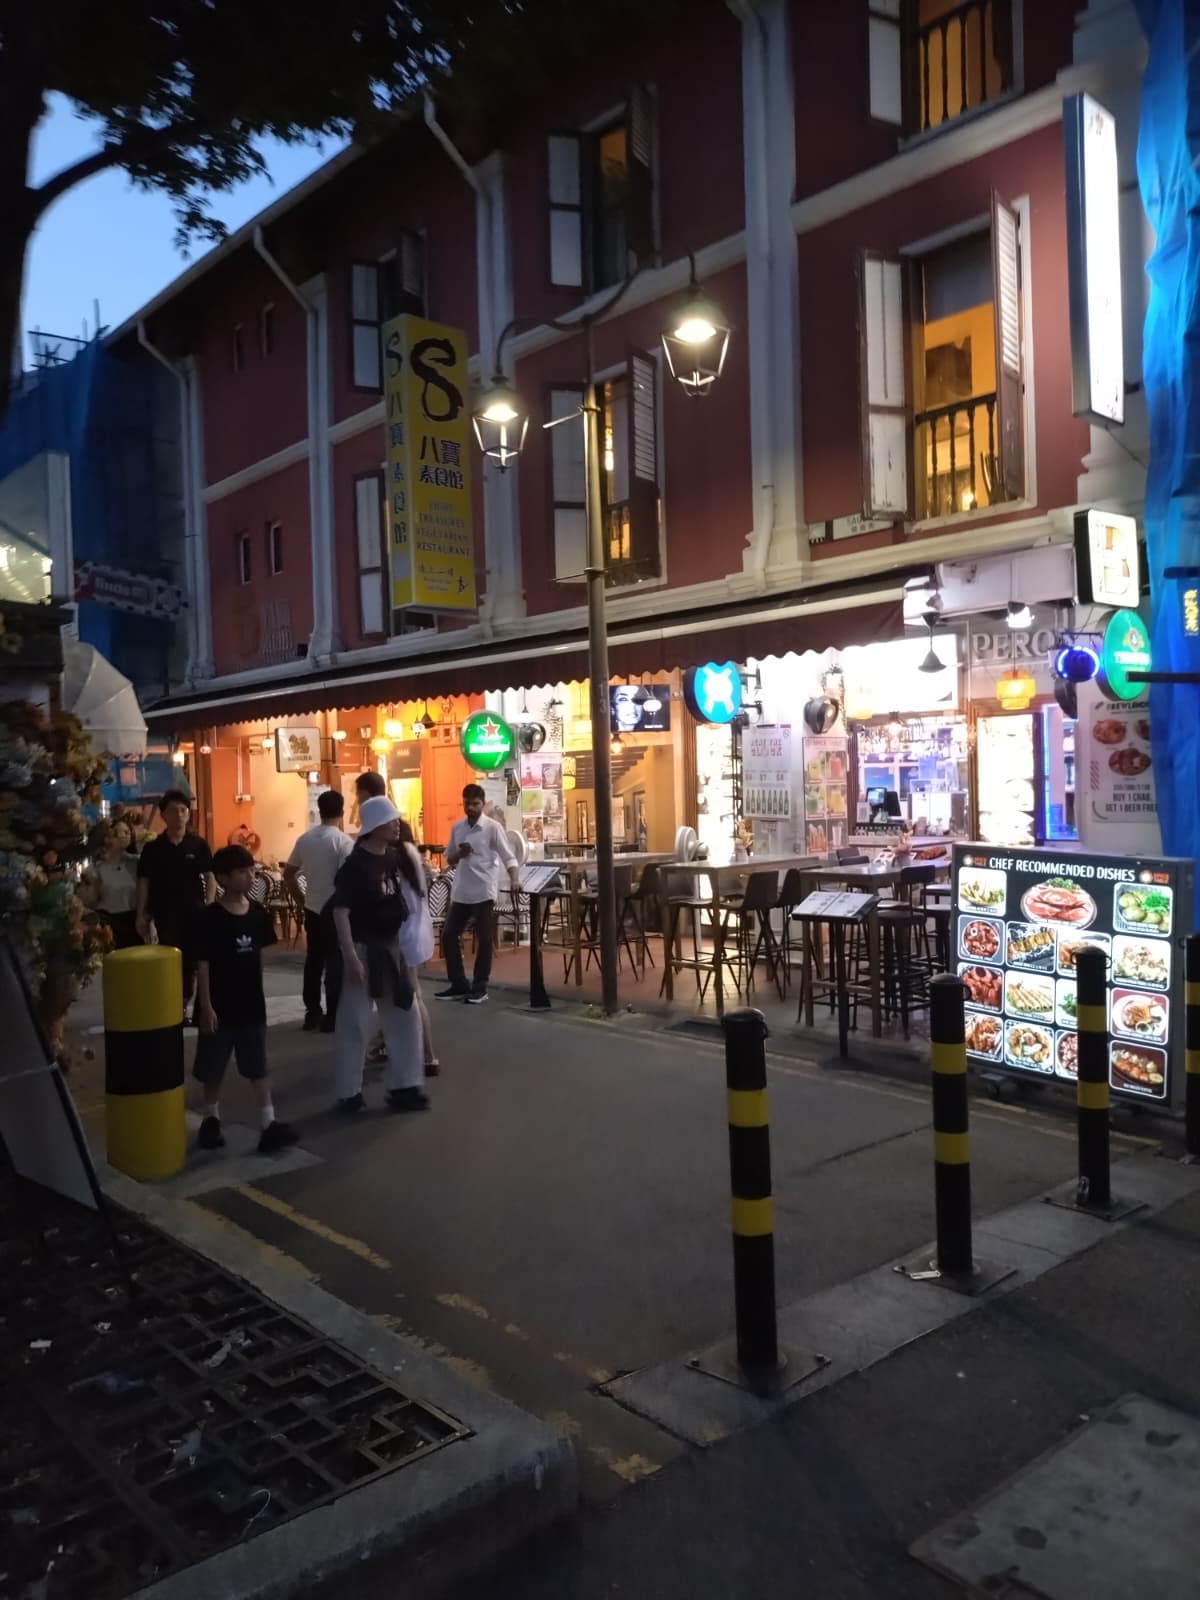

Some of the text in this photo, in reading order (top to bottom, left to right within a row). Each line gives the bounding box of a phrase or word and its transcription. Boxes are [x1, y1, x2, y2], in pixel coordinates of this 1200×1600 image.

[416, 542, 471, 557] RESTAURANT
[989, 857, 1014, 871] CHEF
[1015, 860, 1095, 879] RECOMMENDED
[1096, 866, 1136, 882] DISHES
